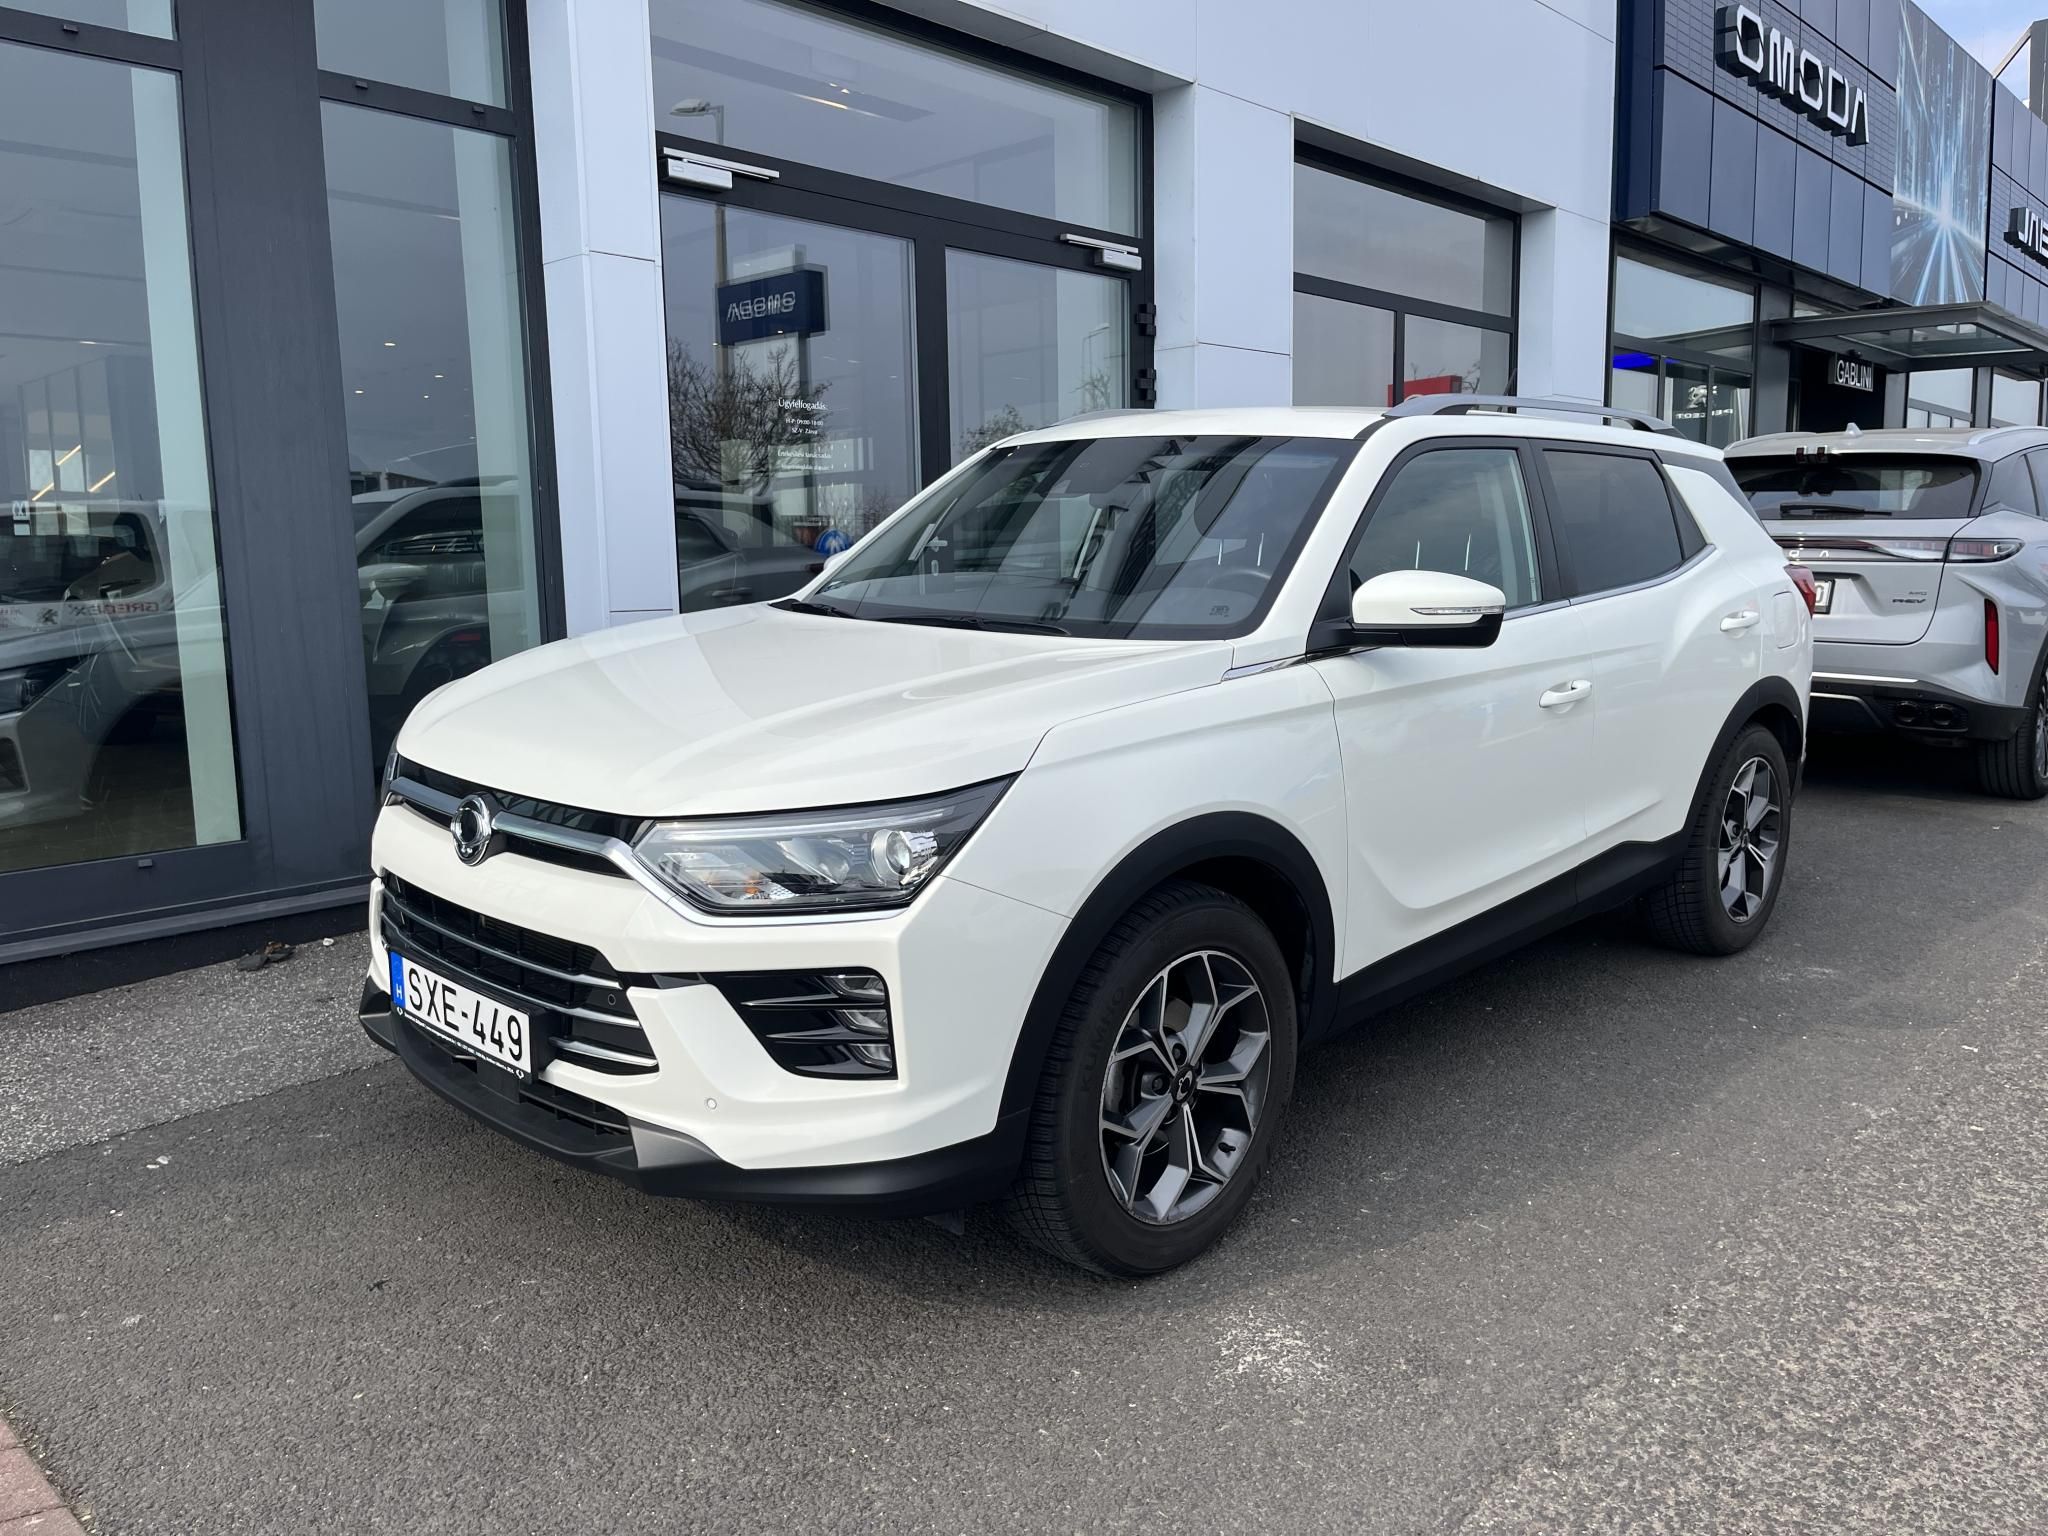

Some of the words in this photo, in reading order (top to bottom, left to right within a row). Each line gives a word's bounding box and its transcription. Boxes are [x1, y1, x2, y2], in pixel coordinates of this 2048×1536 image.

[1736, 4, 1870, 144] OMODA
[1836, 359, 1872, 389] GABLINI
[396, 983, 403, 1000] H
[408, 967, 522, 1062] SXE-449
